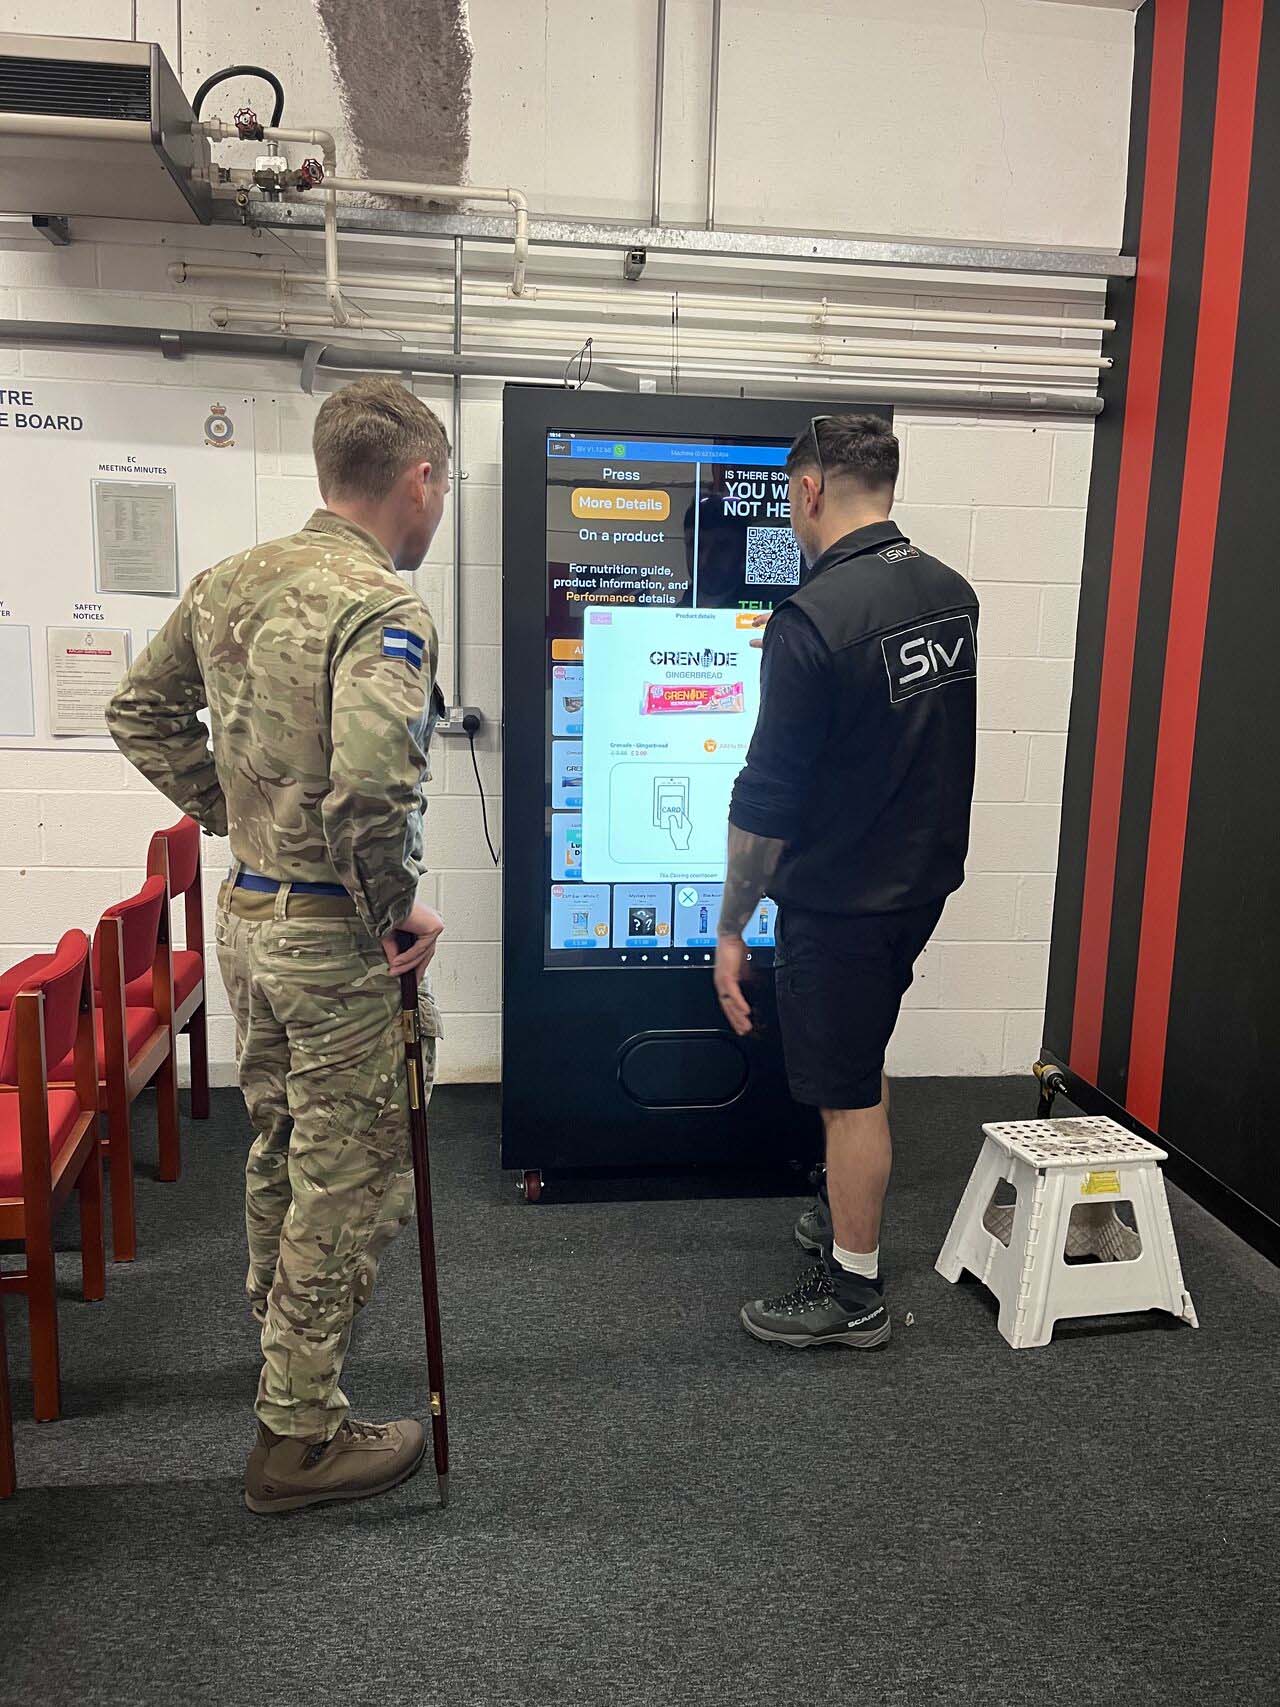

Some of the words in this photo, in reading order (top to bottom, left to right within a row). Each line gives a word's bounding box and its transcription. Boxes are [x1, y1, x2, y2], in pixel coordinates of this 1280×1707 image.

[15, 413, 83, 431] BOARD
[98, 464, 132, 473] MEETING
[133, 466, 167, 475] MINUTES
[602, 467, 641, 481] Press
[725, 470, 734, 479] IS
[736, 470, 769, 480] THERE
[725, 482, 765, 500] YOU
[771, 483, 790, 500] W
[579, 496, 612, 509] More
[615, 497, 663, 511] Details
[723, 501, 762, 517] NOT
[579, 528, 597, 541] On
[601, 532, 610, 542] a
[613, 531, 665, 544] product
[569, 563, 588, 574] For
[590, 564, 638, 575] nutrition
[640, 565, 674, 578] guide,
[553, 578, 597, 589] product
[599, 579, 666, 591] information,
[668, 581, 689, 590] and
[566, 591, 636, 603] Performance
[638, 594, 676, 604] details
[75, 603, 102, 611] SAFETY
[73, 613, 105, 621] NOTICES
[665, 671, 723, 680] GINGERBREAD
[661, 806, 682, 814] CARD
